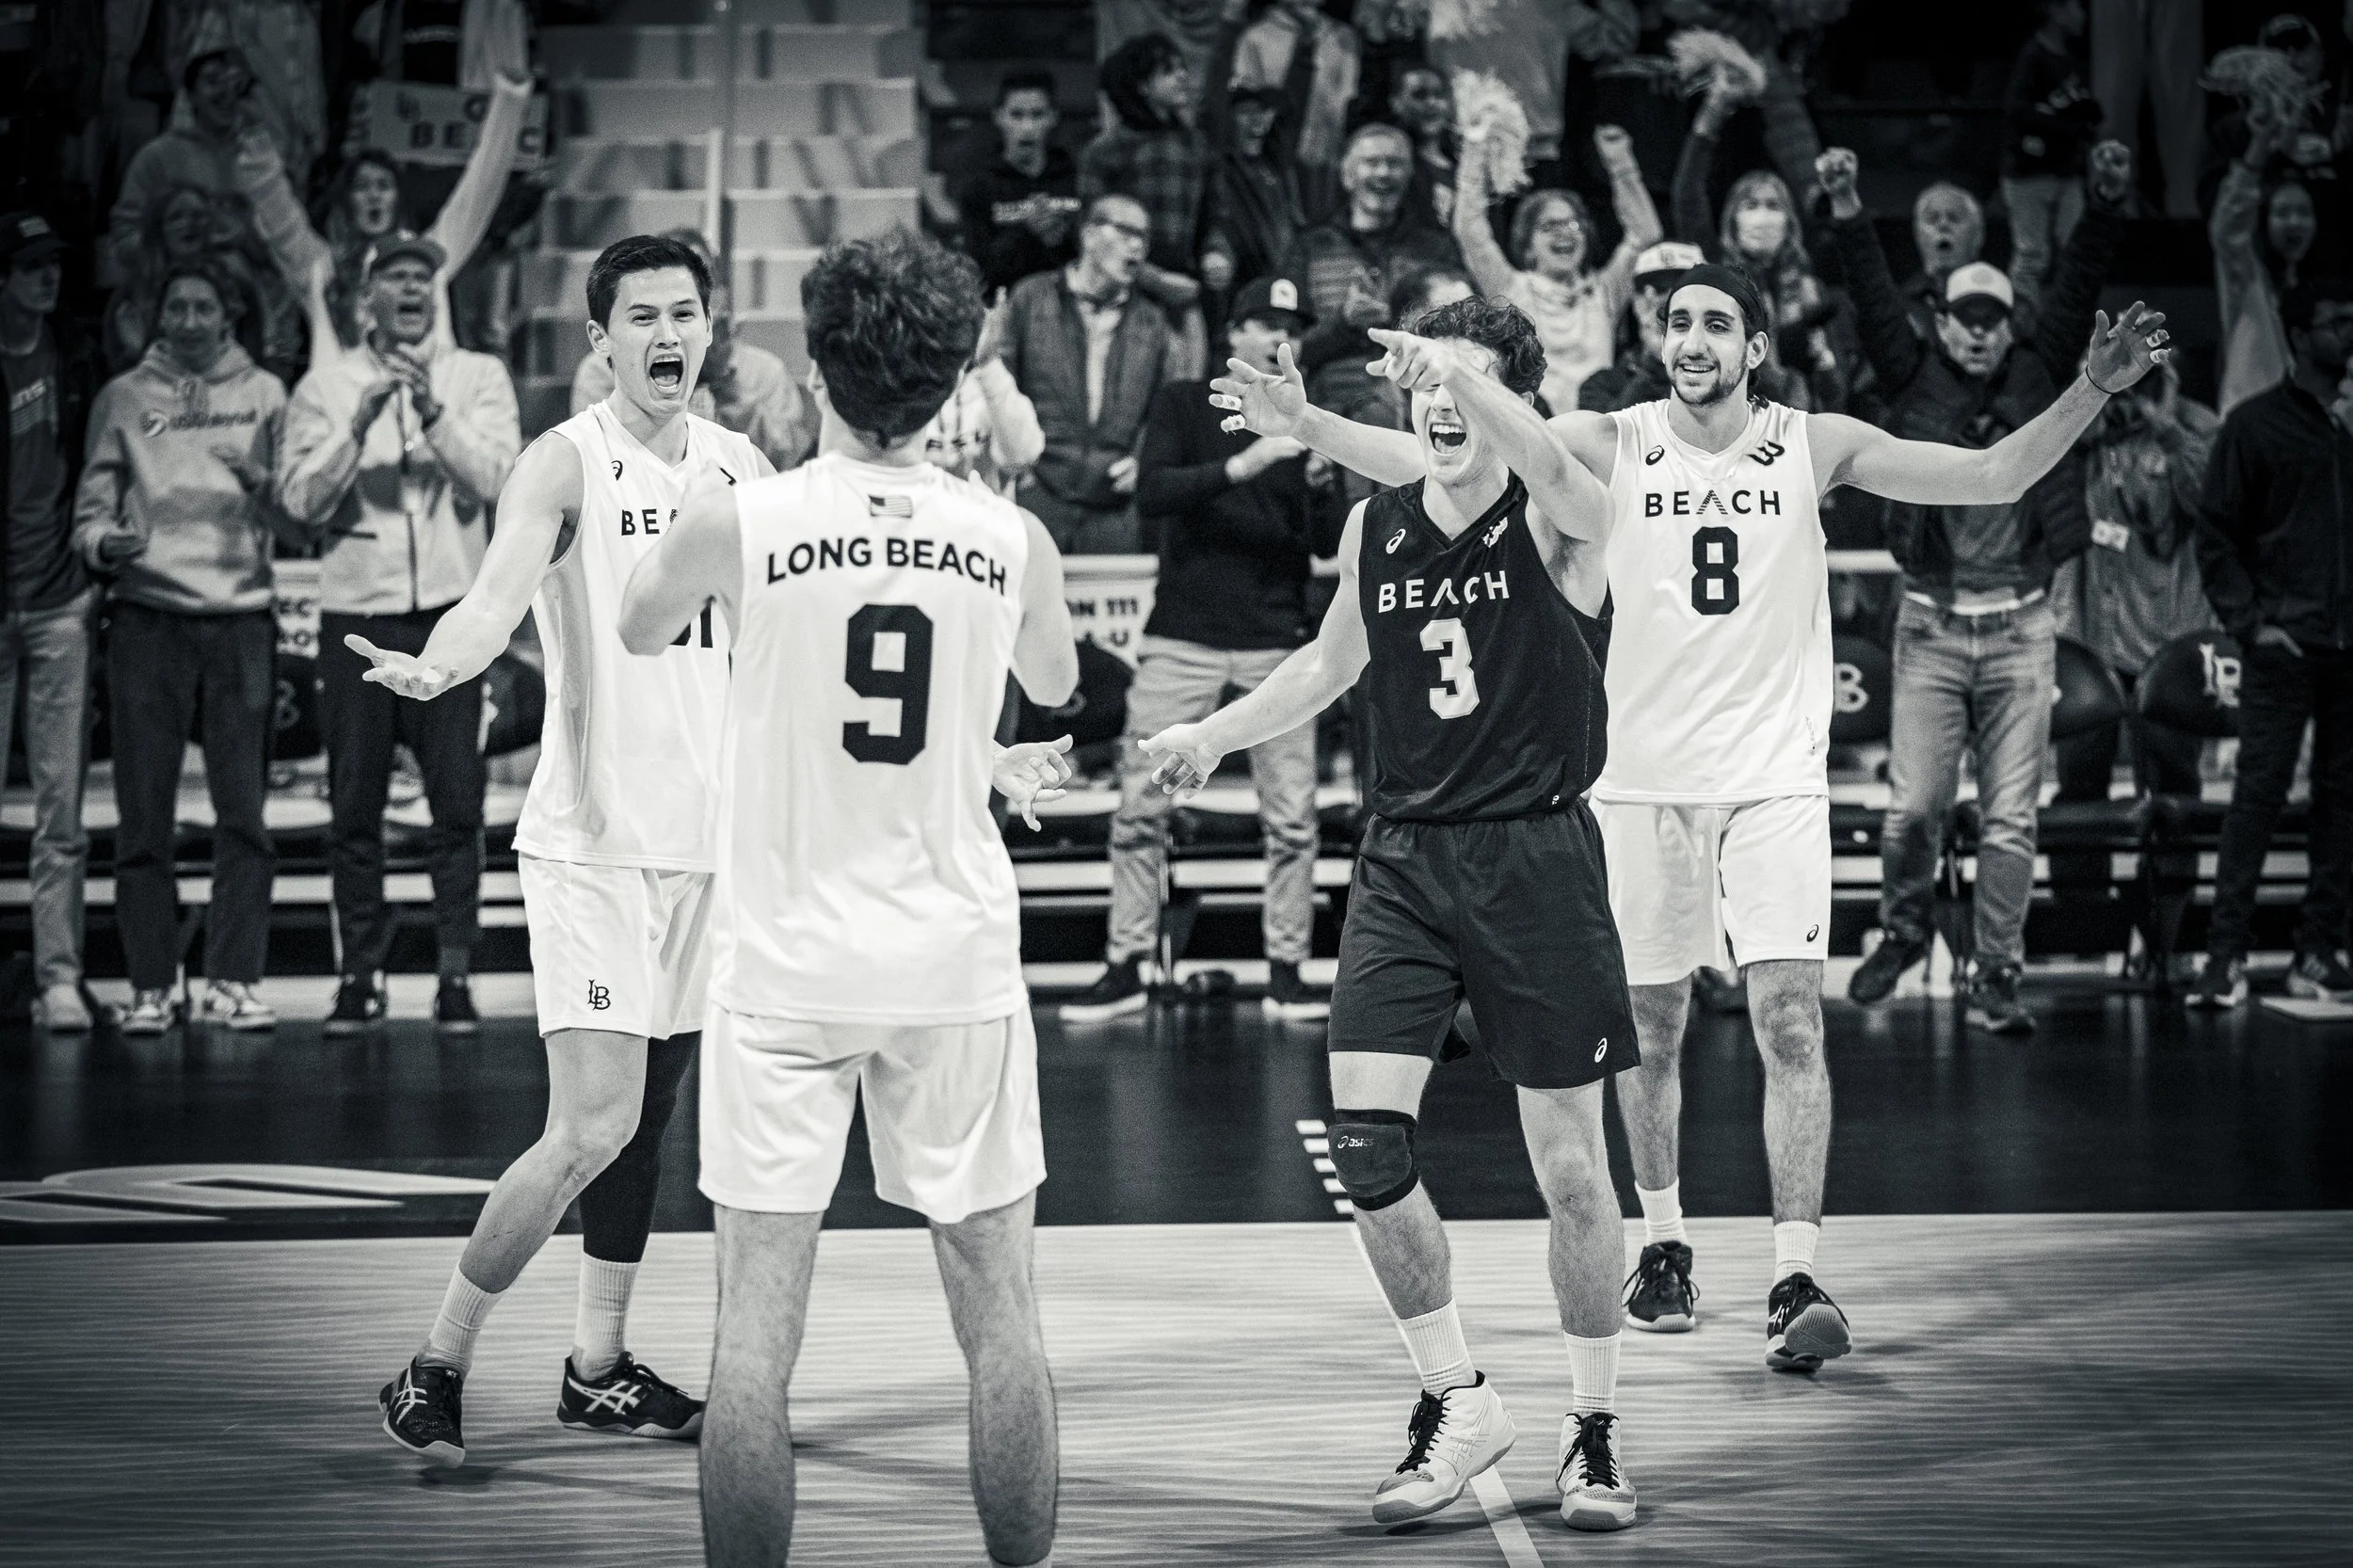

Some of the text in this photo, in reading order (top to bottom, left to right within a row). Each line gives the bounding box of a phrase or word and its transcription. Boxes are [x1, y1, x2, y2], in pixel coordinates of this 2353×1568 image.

[1645, 489, 1781, 518] BEACH
[767, 536, 1005, 595] LONG BEACH
[1378, 569, 1510, 614] BEACH
[1691, 526, 1739, 616] 8
[842, 603, 934, 765] 9
[1419, 617, 1481, 720] 3
[587, 979, 611, 1010] LB
[1348, 1137, 1374, 1147] asics
